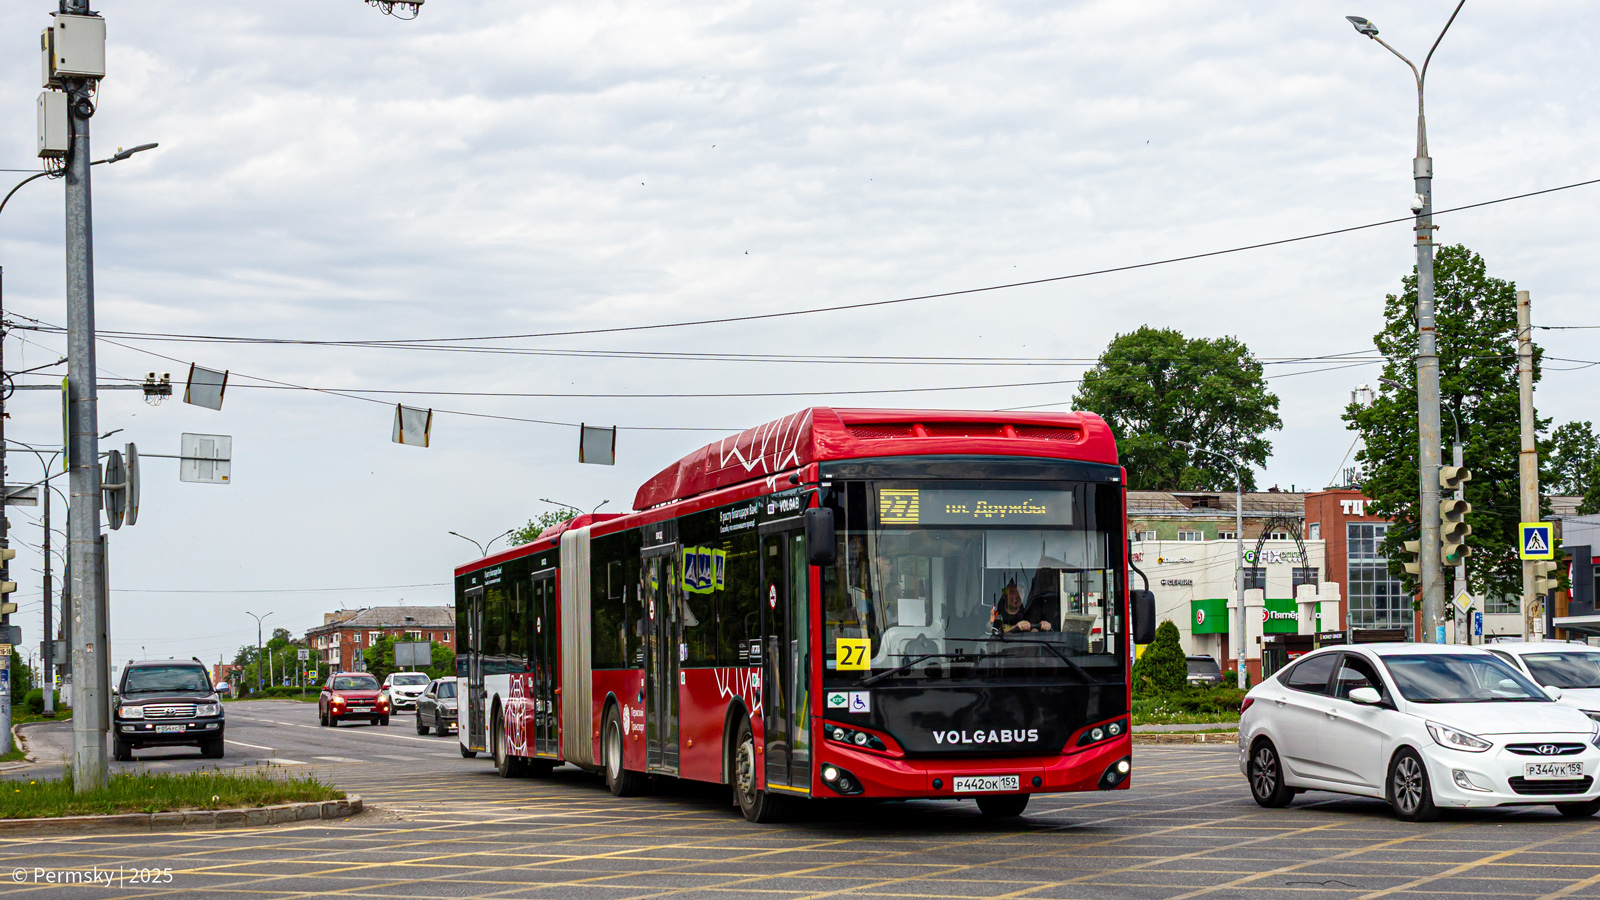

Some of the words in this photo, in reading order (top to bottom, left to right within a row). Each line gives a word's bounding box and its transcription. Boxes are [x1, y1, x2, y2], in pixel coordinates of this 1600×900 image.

[1340, 499, 1364, 517] ТЦ
[840, 645, 867, 666] 27
[932, 729, 1039, 744] VOLGABUS
[956, 778, 998, 790] Р442ОК
[1000, 777, 1016, 786] 159
